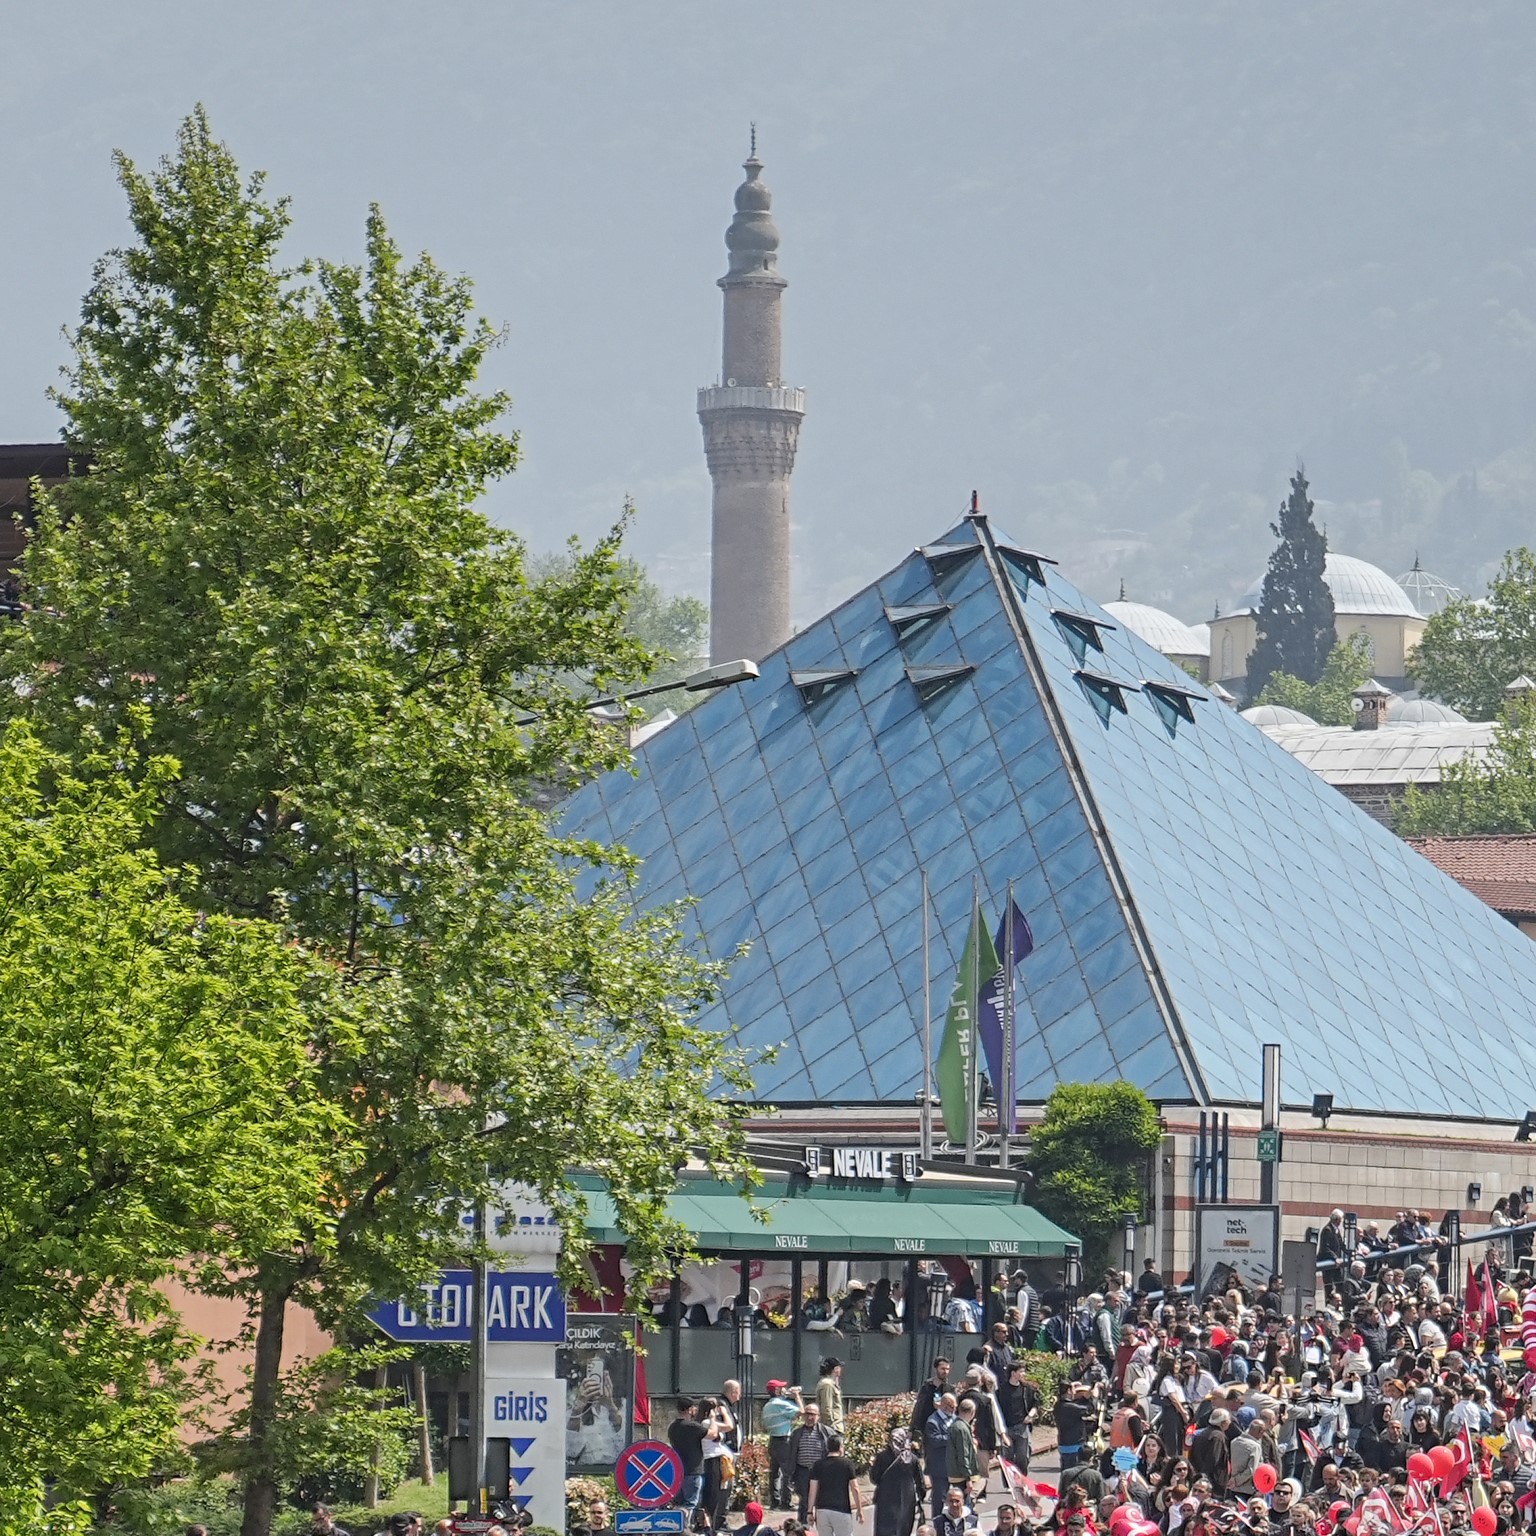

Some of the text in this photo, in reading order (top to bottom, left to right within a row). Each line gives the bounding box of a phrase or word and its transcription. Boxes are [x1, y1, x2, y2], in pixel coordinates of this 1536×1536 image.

[833, 1149, 892, 1179] NEVALE
[1226, 1226, 1247, 1235] tech
[775, 1235, 808, 1249] NEVALE
[894, 1238, 926, 1251] NEVALE
[988, 1240, 1018, 1253] NEVALE
[493, 1390, 549, 1425] GİRİŞ
